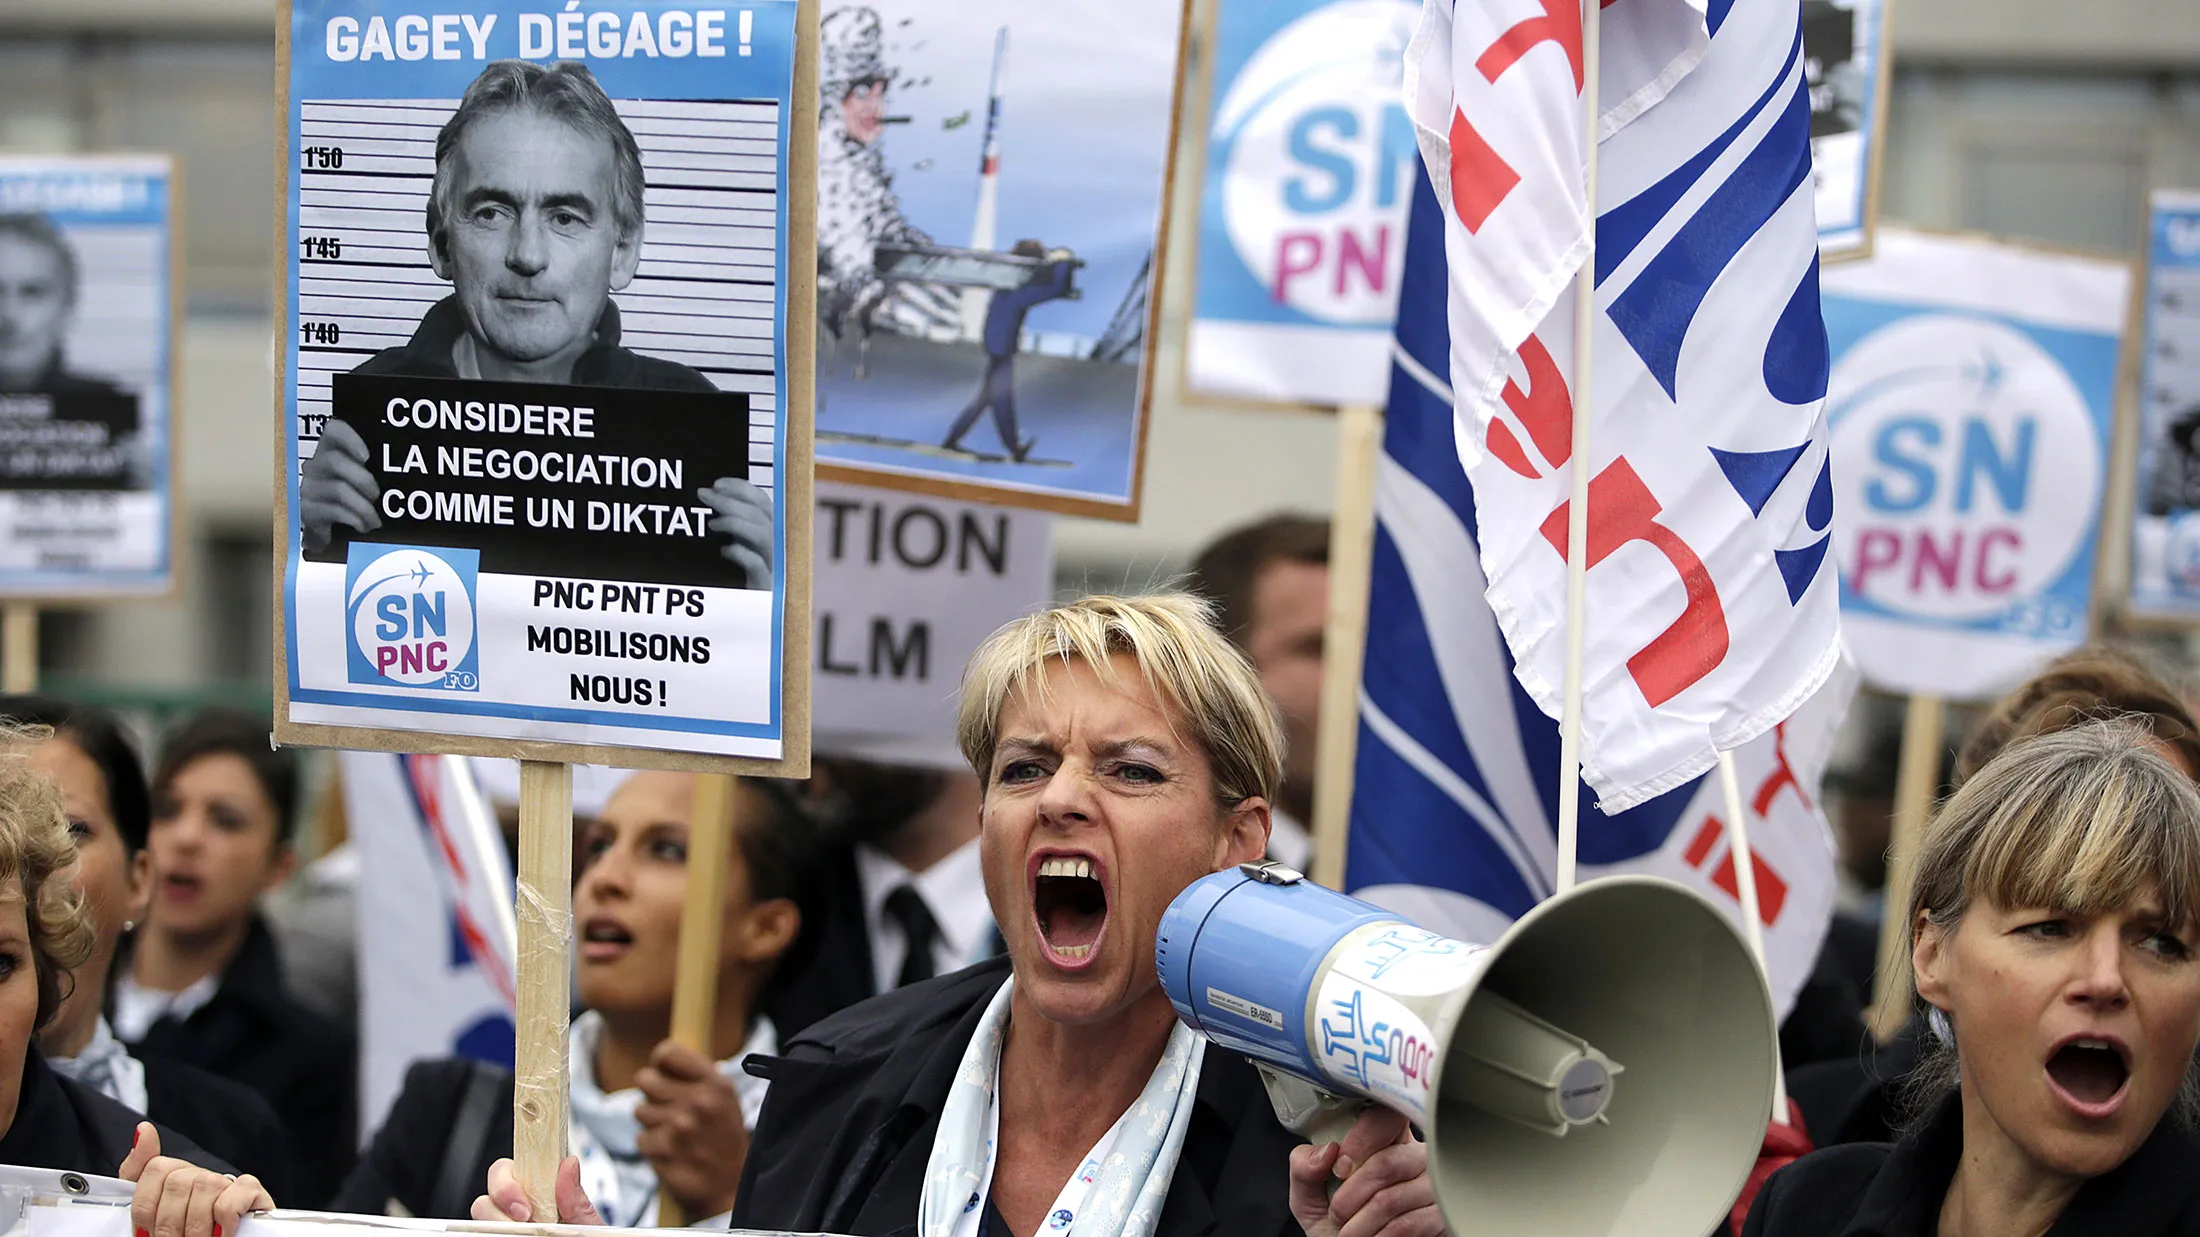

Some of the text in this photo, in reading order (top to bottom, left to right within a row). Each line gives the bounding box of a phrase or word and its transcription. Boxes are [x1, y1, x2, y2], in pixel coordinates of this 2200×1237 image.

[326, 13, 498, 62] GAGEY
[518, 1, 727, 60] DÉGAGE
[304, 147, 343, 169] 1'50
[303, 237, 341, 259] 1'45
[1274, 224, 1390, 304] PN
[302, 322, 340, 345] 1'40
[302, 414, 331, 435] 1'3
[382, 443, 683, 489] LA NEGOCIATION
[1865, 416, 2036, 513] SN
[382, 489, 713, 538] COMME UN DIKTAT
[818, 498, 1011, 575] TION
[1853, 527, 2020, 596] PNC
[376, 590, 446, 642] SN
[533, 579, 705, 618] PNC PNT PS
[377, 641, 448, 677] PNC
[527, 625, 711, 665] MOBILISONS
[819, 611, 930, 680] LM
[444, 670, 477, 690] FO
[569, 673, 653, 707] NOUS
